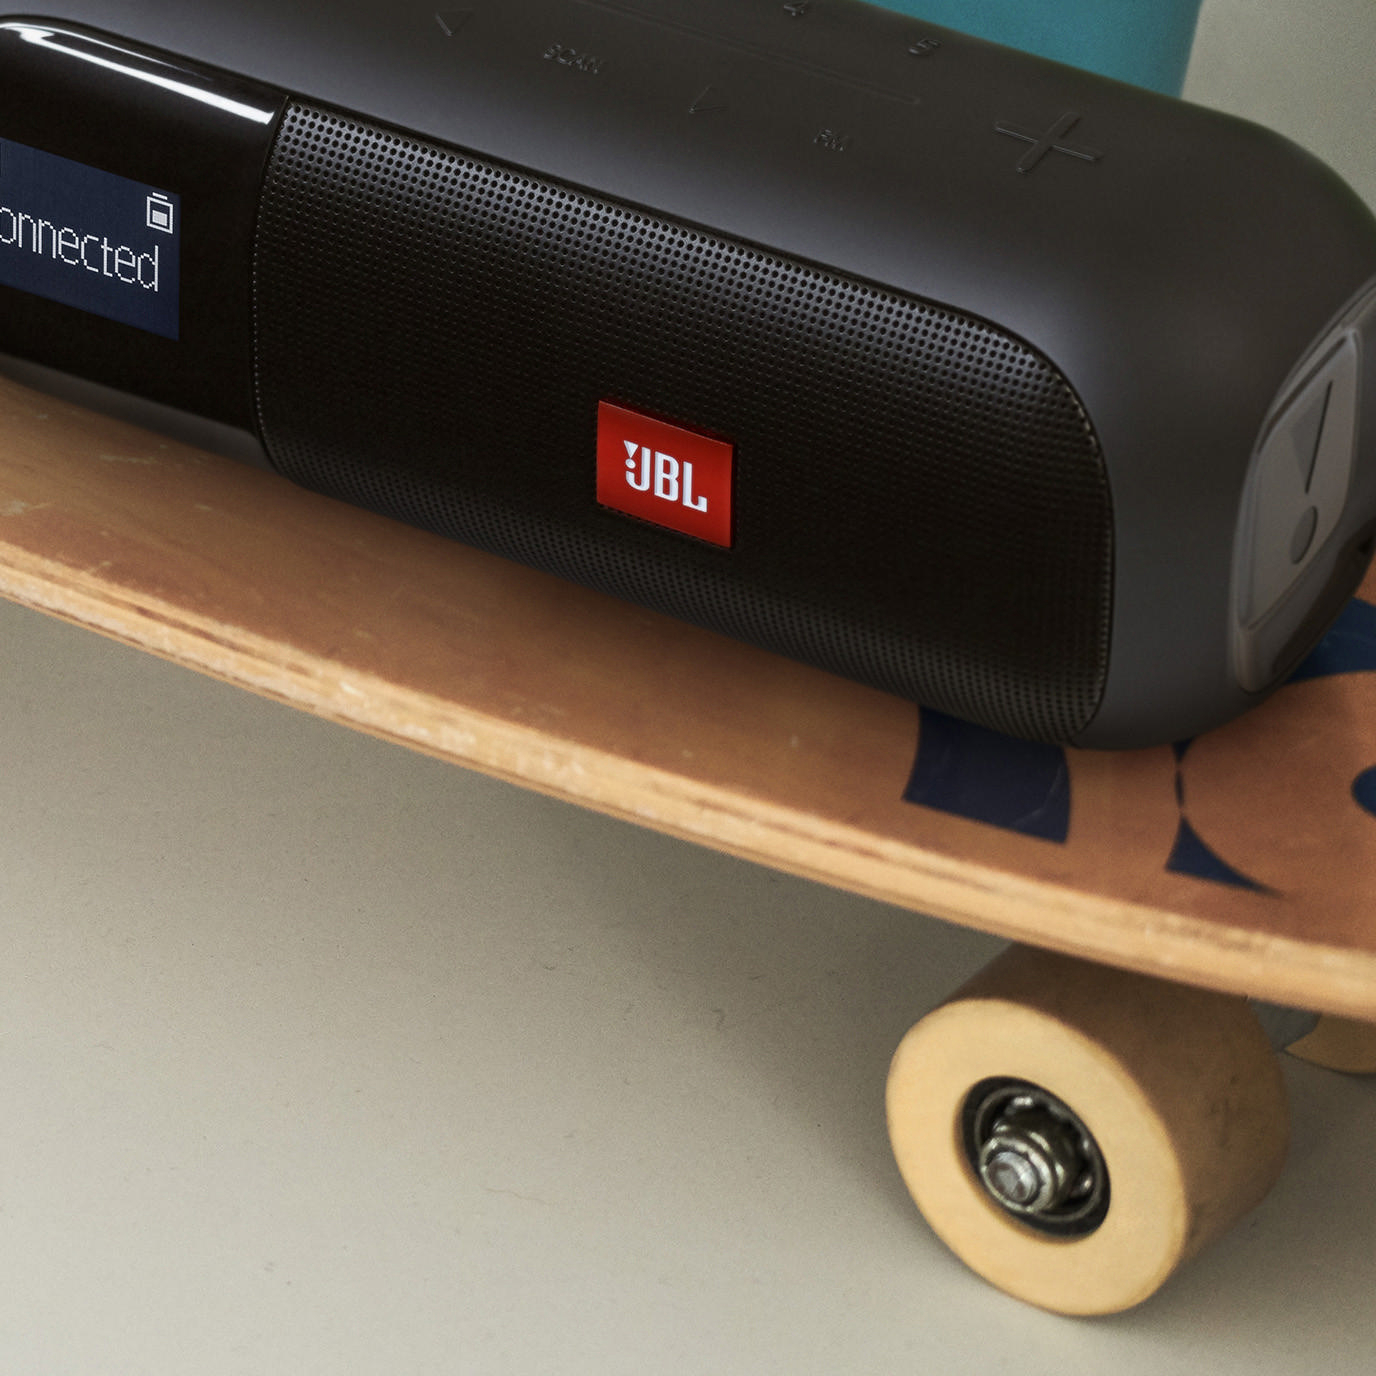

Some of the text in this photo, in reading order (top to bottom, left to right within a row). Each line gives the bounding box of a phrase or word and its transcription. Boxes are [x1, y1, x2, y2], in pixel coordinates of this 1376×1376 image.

[543, 39, 603, 75] SCAN
[782, 0, 810, 17] 4
[908, 37, 945, 57] 5
[624, 442, 708, 513] JBL
